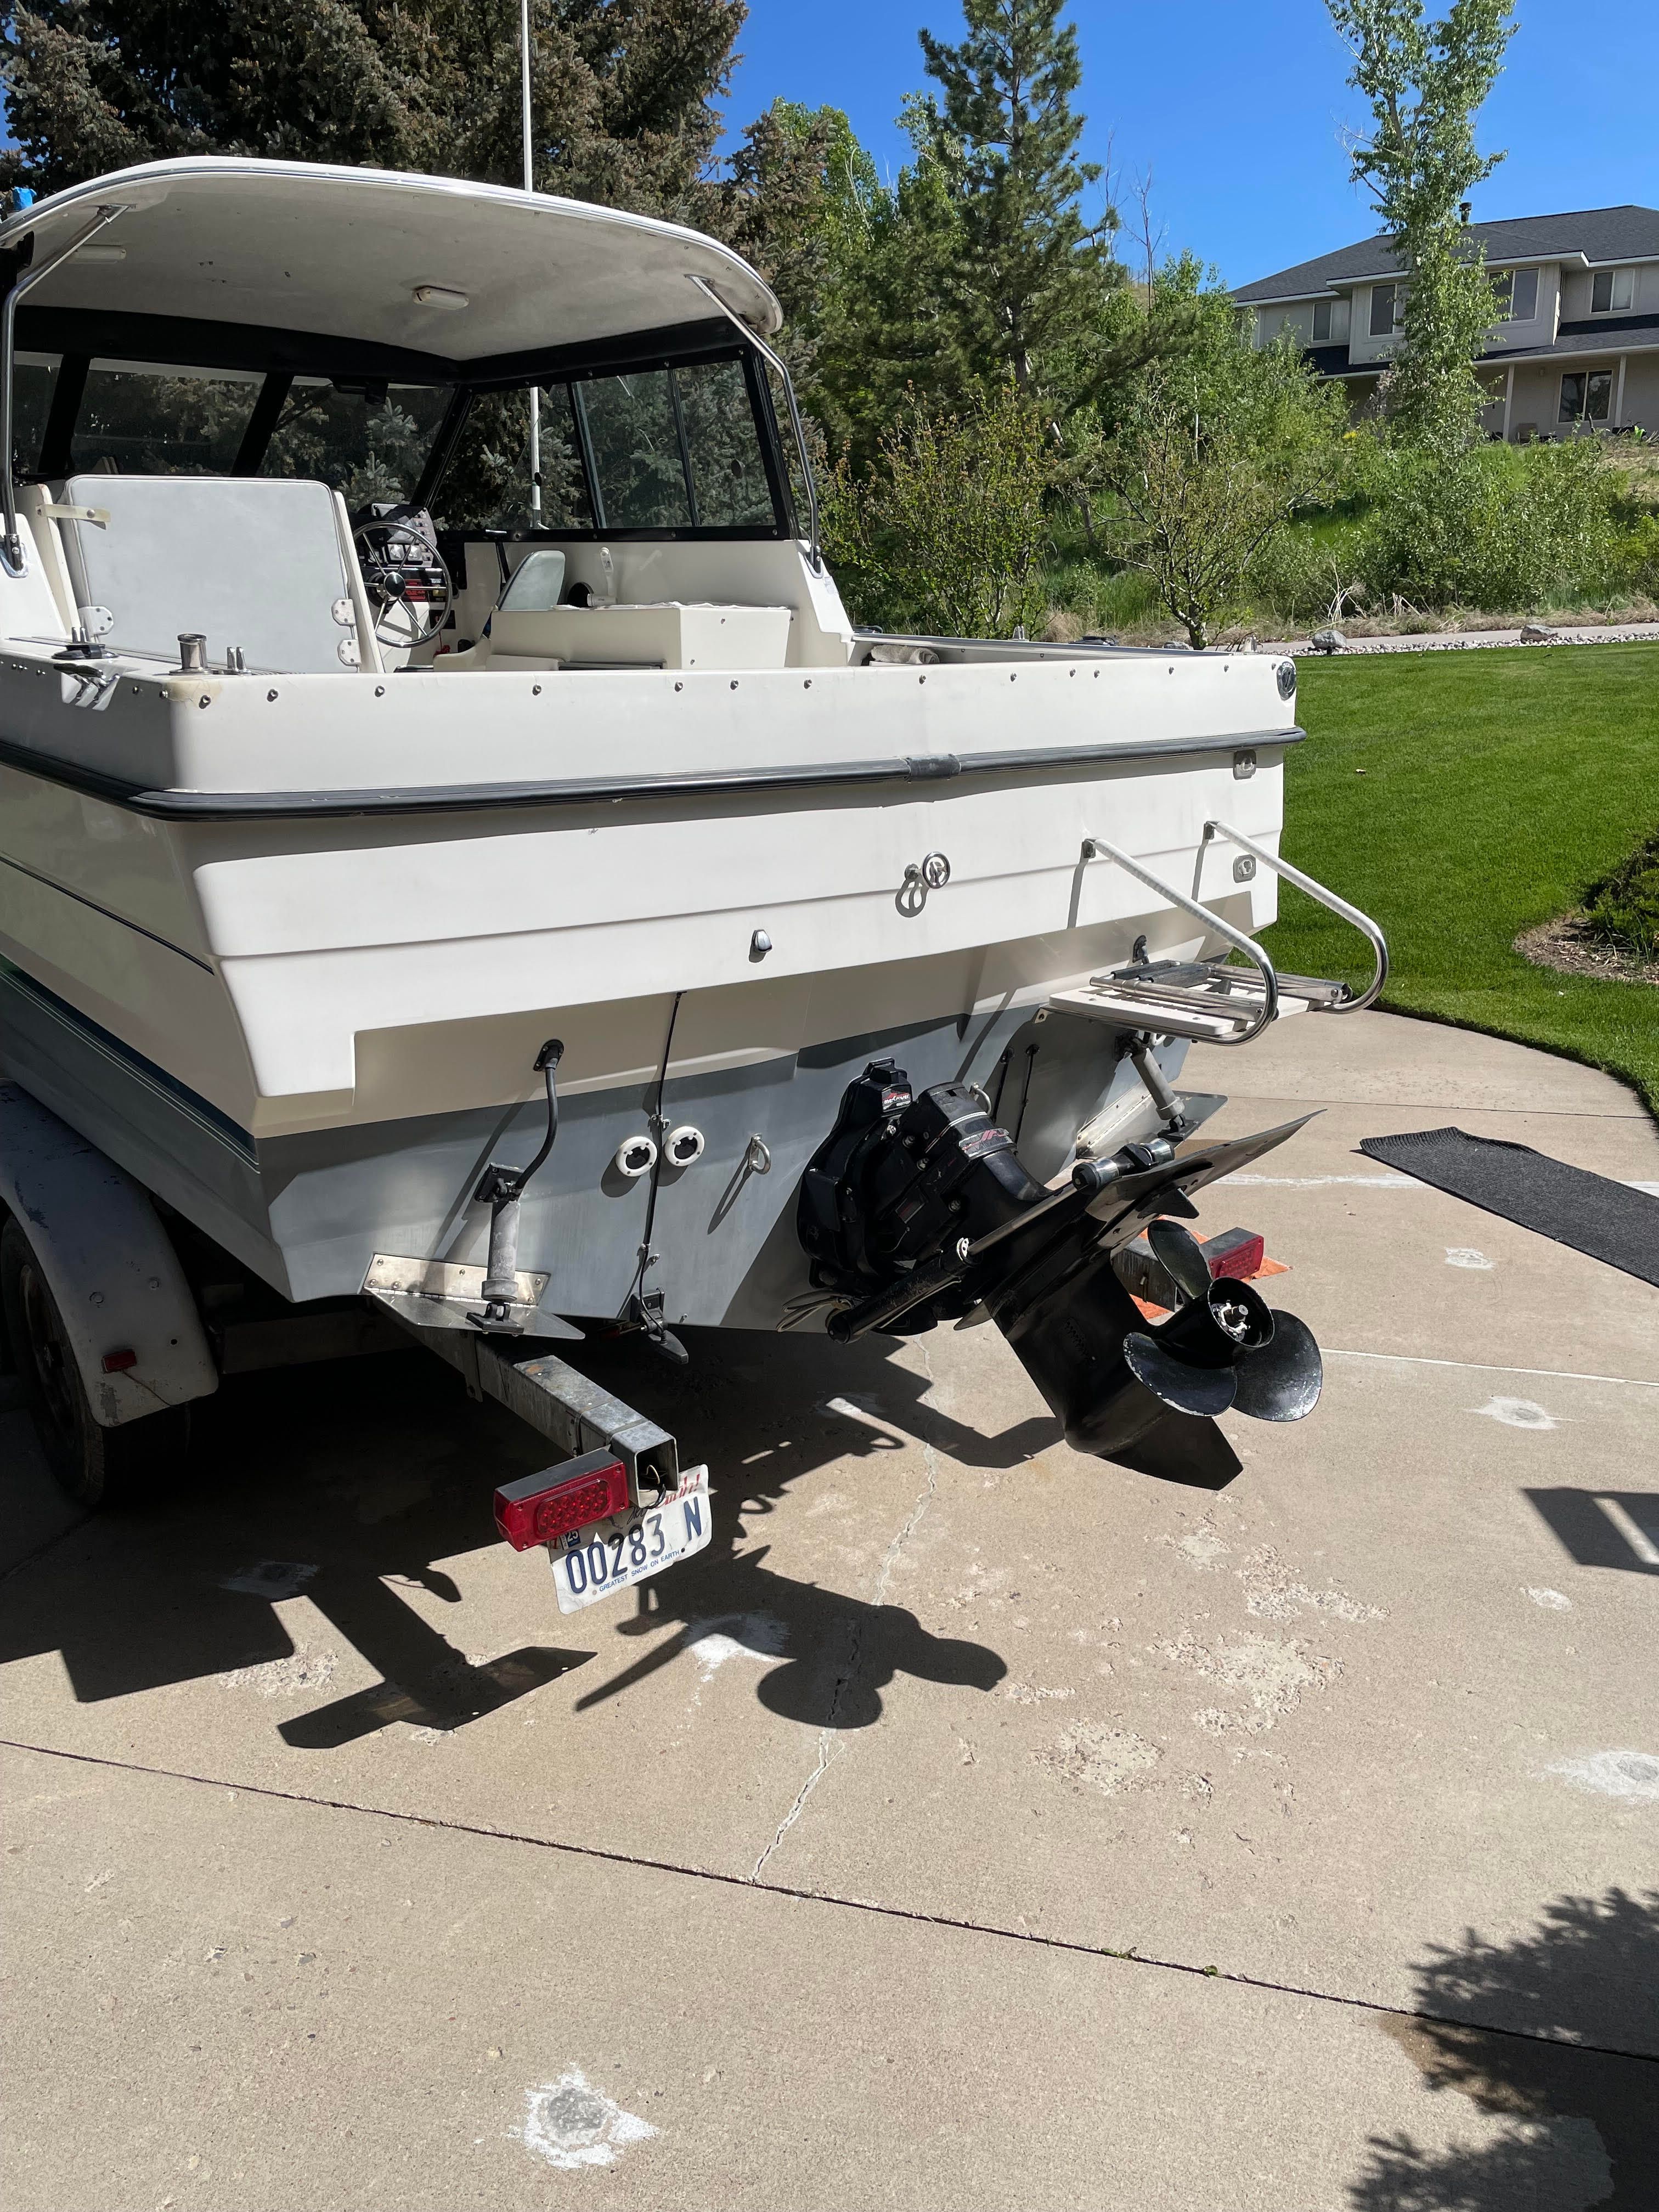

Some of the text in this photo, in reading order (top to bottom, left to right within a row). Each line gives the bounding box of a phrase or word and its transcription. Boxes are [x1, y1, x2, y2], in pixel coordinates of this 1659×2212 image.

[566, 1496, 702, 1593] 00283 N
[599, 1550, 680, 1592] GREATEST SNOW ON EARTH
